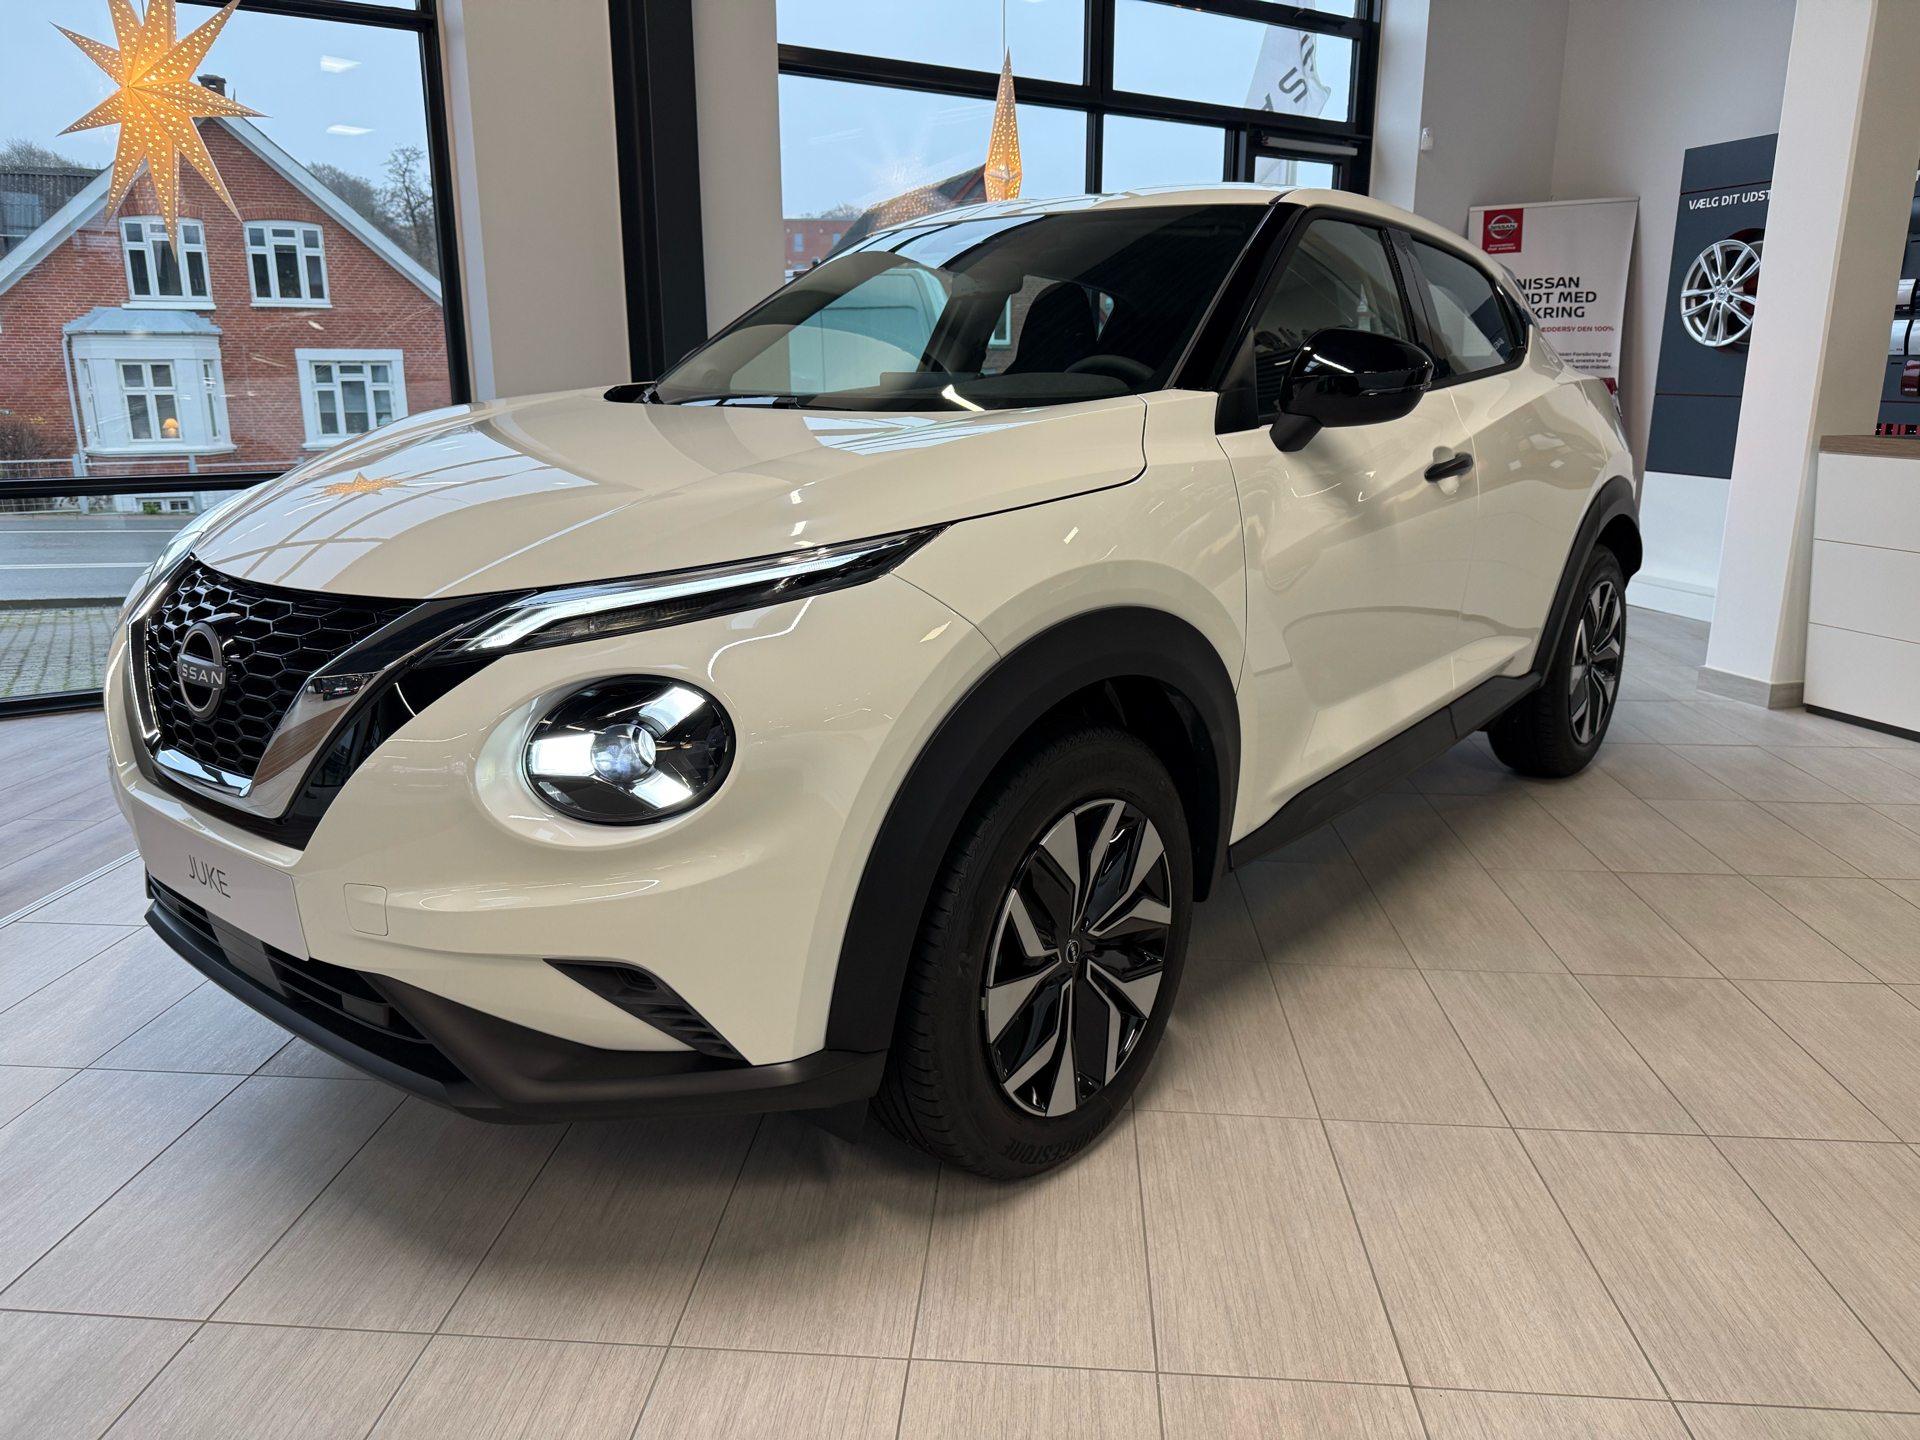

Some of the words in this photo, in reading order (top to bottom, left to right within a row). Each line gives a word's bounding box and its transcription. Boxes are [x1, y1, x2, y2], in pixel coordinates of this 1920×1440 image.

[1689, 197, 1719, 211] VÆLG
[1721, 194, 1740, 206] DIT
[1517, 276, 1580, 290] NISSAN
[1525, 292, 1554, 305] DT
[1558, 291, 1597, 304] MED
[181, 663, 223, 685] SSAN
[188, 854, 231, 899] JUKE
